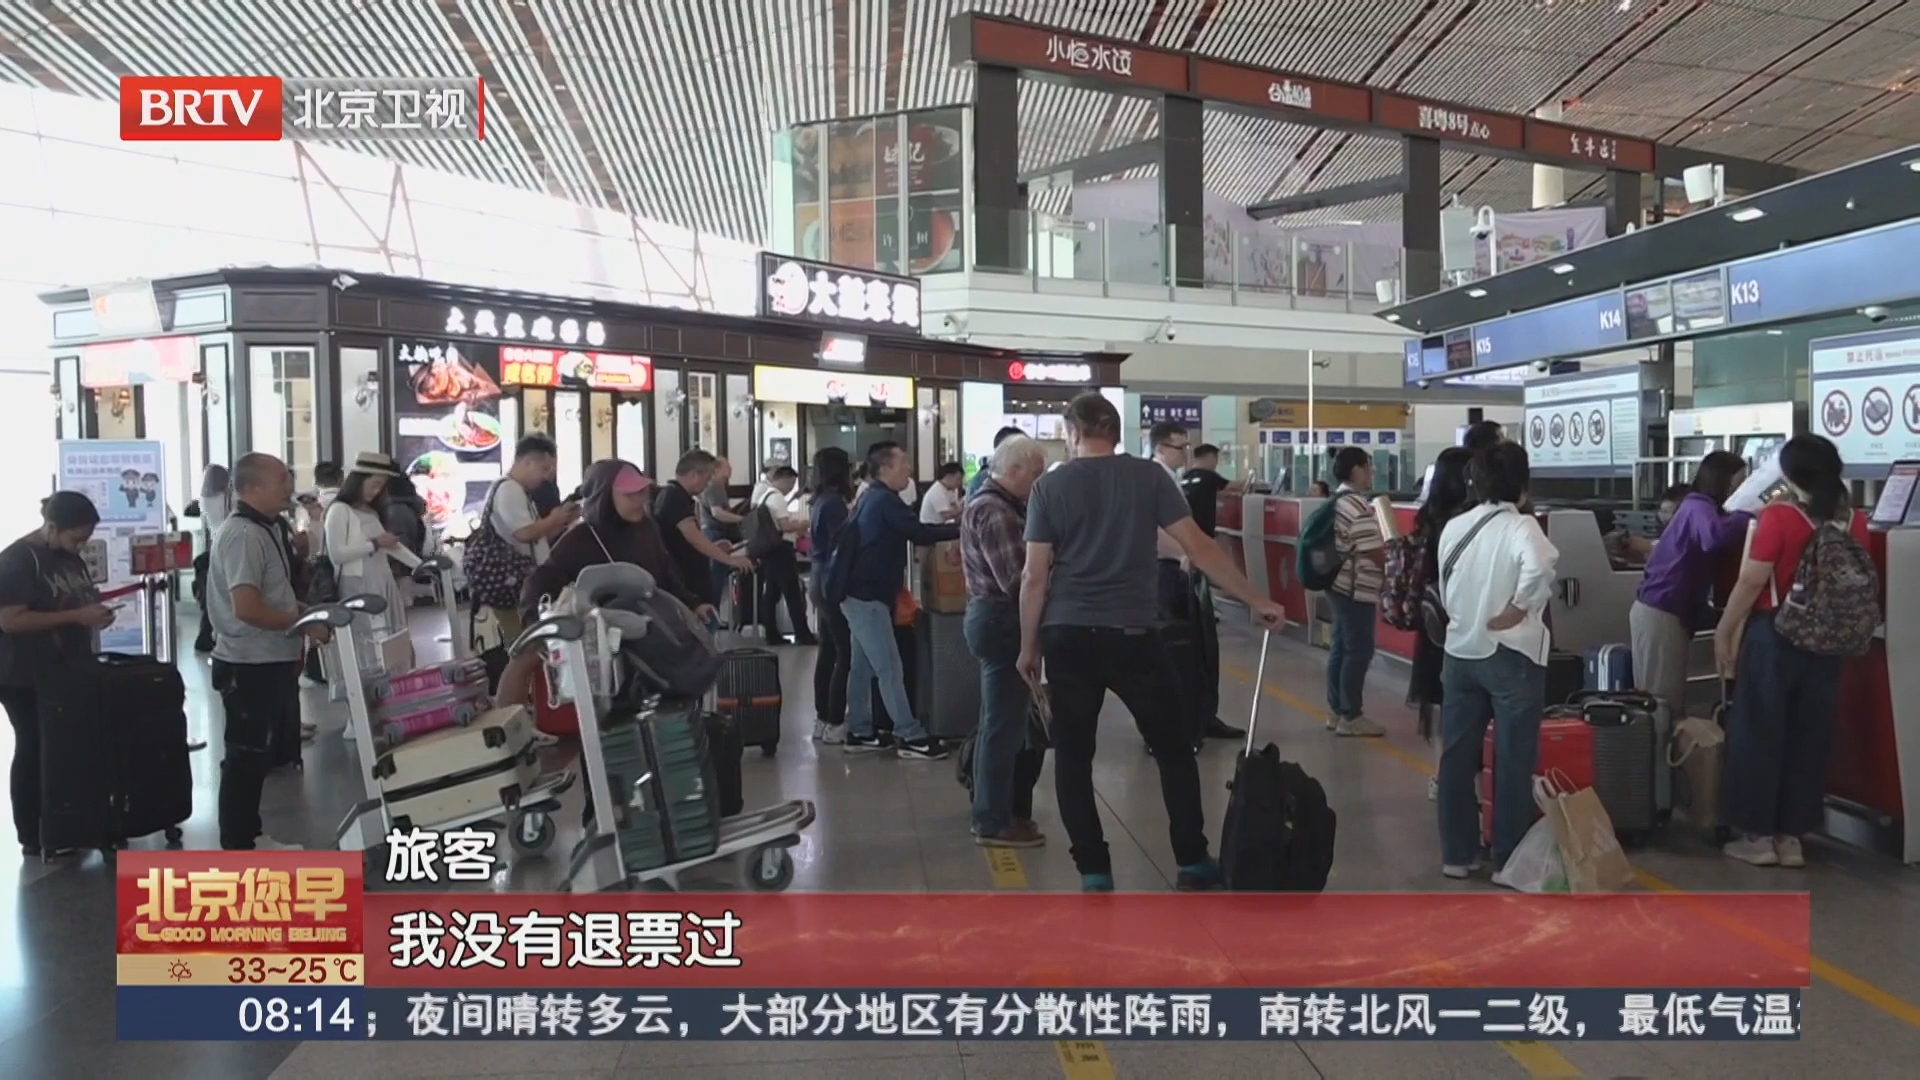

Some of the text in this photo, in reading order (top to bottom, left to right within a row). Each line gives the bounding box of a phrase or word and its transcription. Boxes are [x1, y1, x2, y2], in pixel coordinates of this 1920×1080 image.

[1731, 279, 1760, 306] K13
[1599, 309, 1622, 331] K14
[1476, 337, 1492, 355] K15
